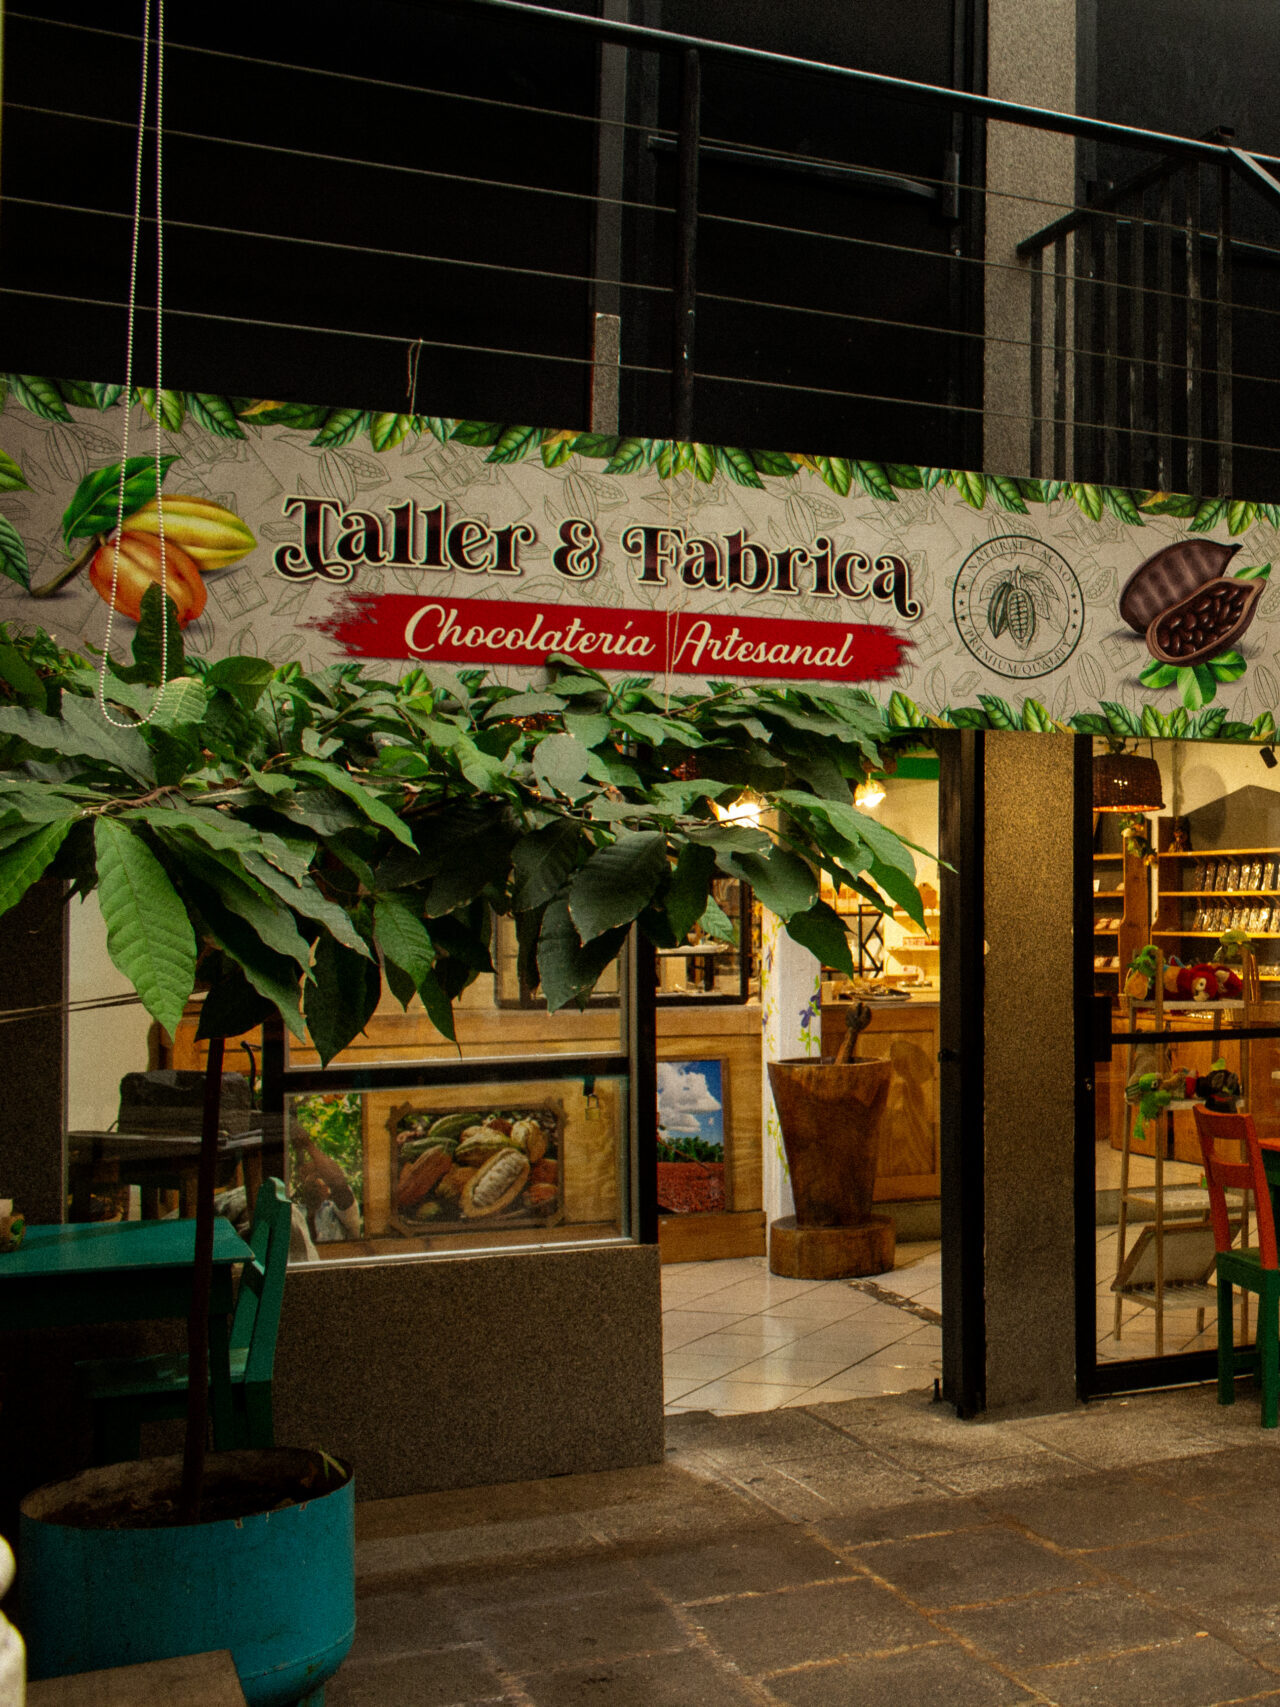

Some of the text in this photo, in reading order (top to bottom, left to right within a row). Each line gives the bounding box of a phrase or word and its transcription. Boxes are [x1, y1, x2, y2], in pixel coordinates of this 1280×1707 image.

[273, 494, 922, 621] Taller & Fabrica
[1032, 543, 1072, 583] CACAO
[403, 603, 855, 669] Chocolatería Artesanal
[963, 627, 1073, 678] PREMIUM QUALITY
